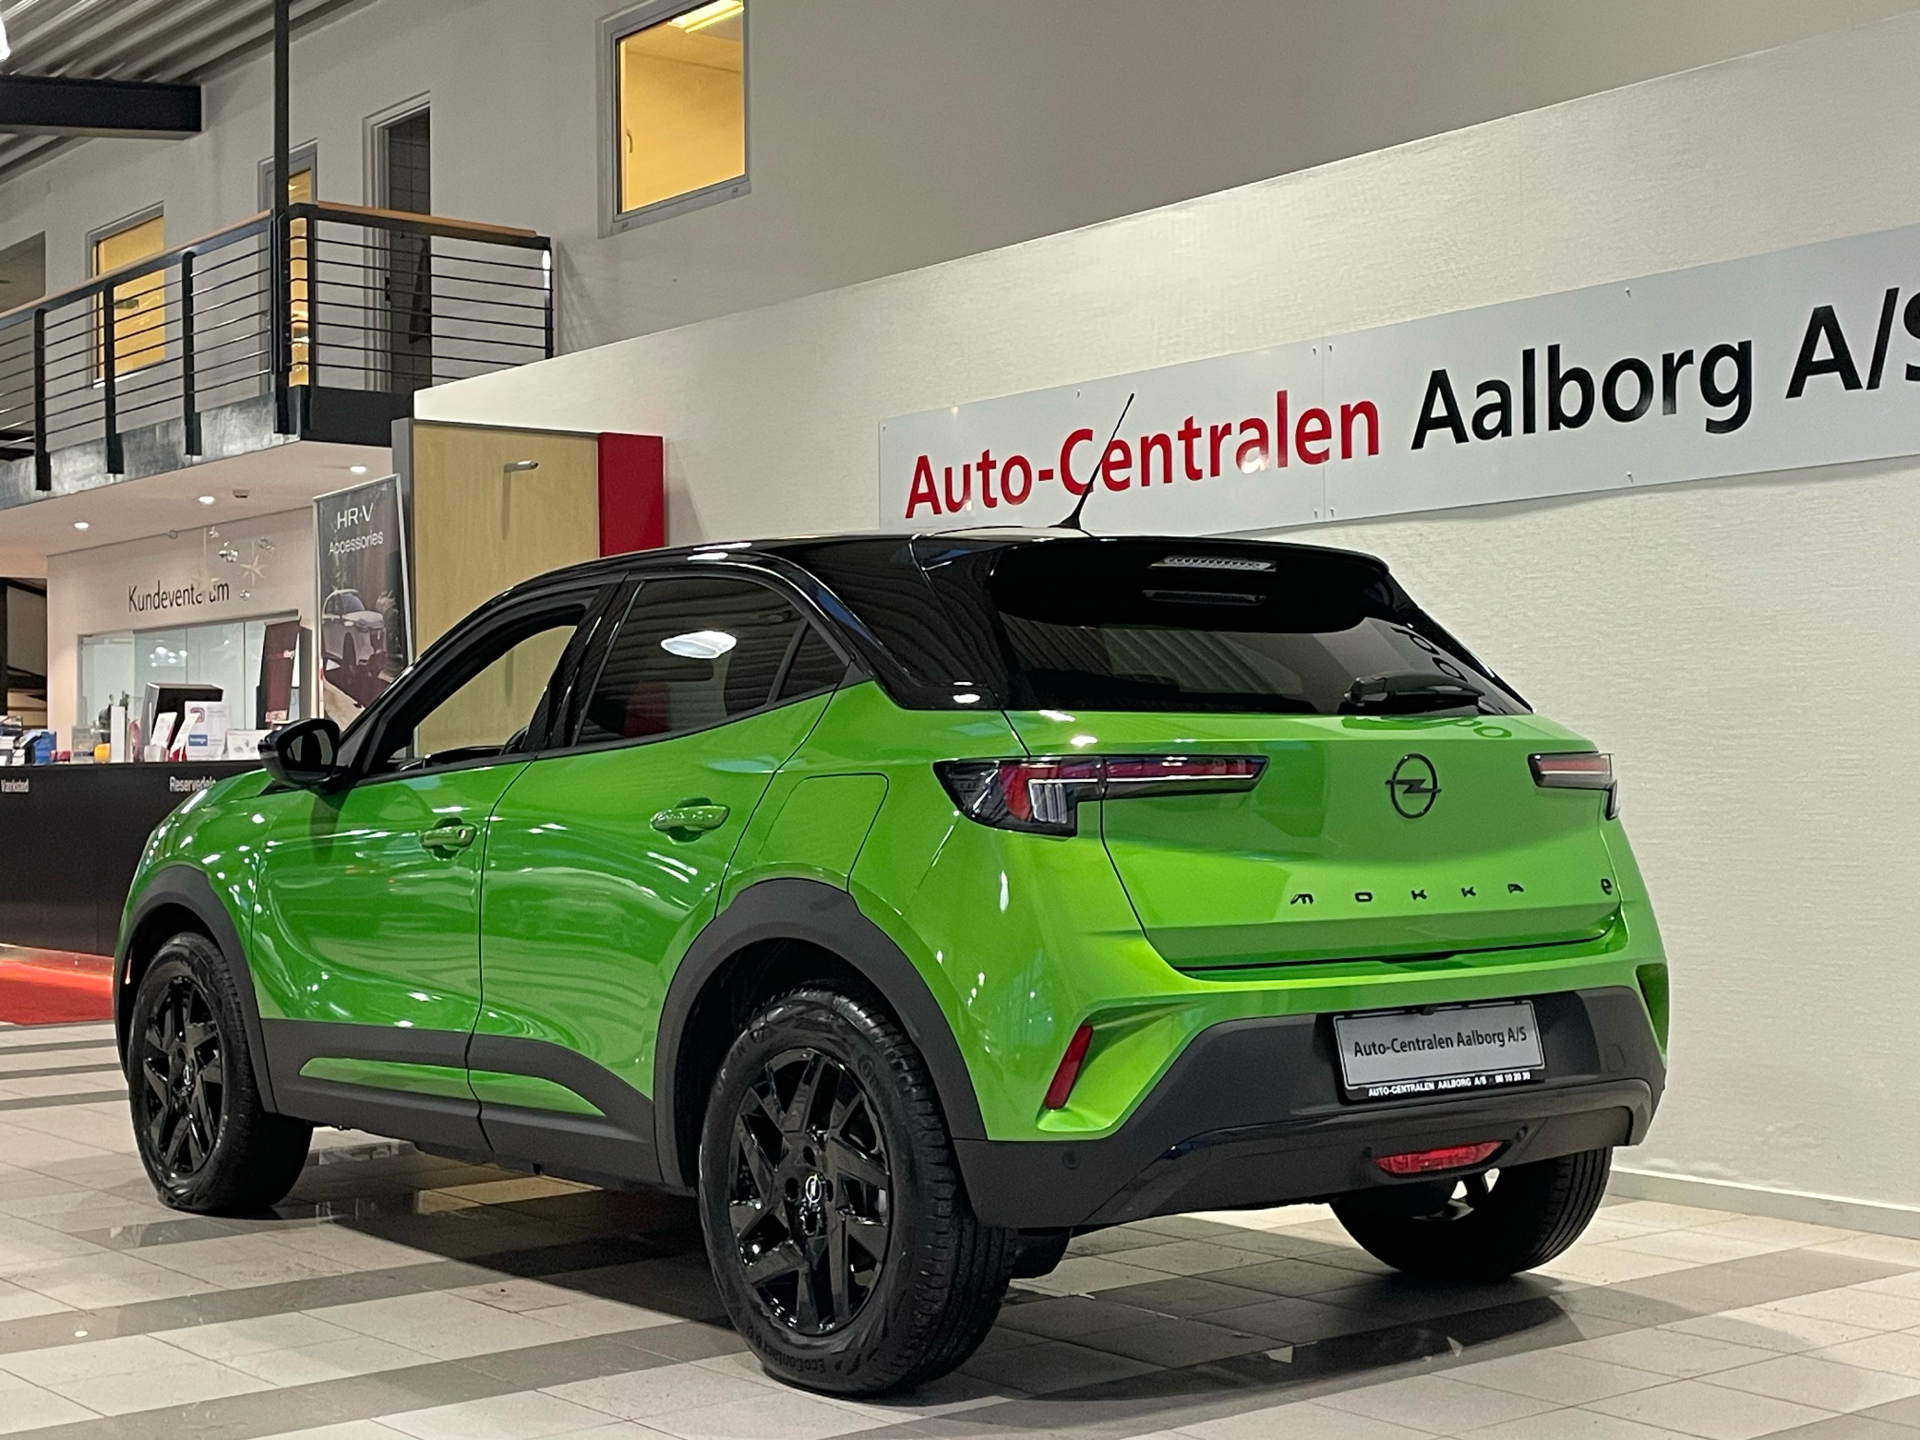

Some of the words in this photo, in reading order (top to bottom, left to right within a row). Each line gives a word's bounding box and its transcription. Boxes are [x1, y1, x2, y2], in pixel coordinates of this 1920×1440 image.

[905, 390, 1380, 519] Auto-Centralen
[1410, 339, 1753, 450] Aalborg
[328, 531, 384, 557] Accessories
[1353, 1033, 1454, 1058] Auto-Centralen
[1456, 1027, 1506, 1049] Aalborg
[1507, 1025, 1528, 1043] A/S
[1367, 1082, 1435, 1097] AUTO-CENTRALEN
[1437, 1077, 1472, 1090] AALBORG
[1474, 1075, 1487, 1087] A/S
